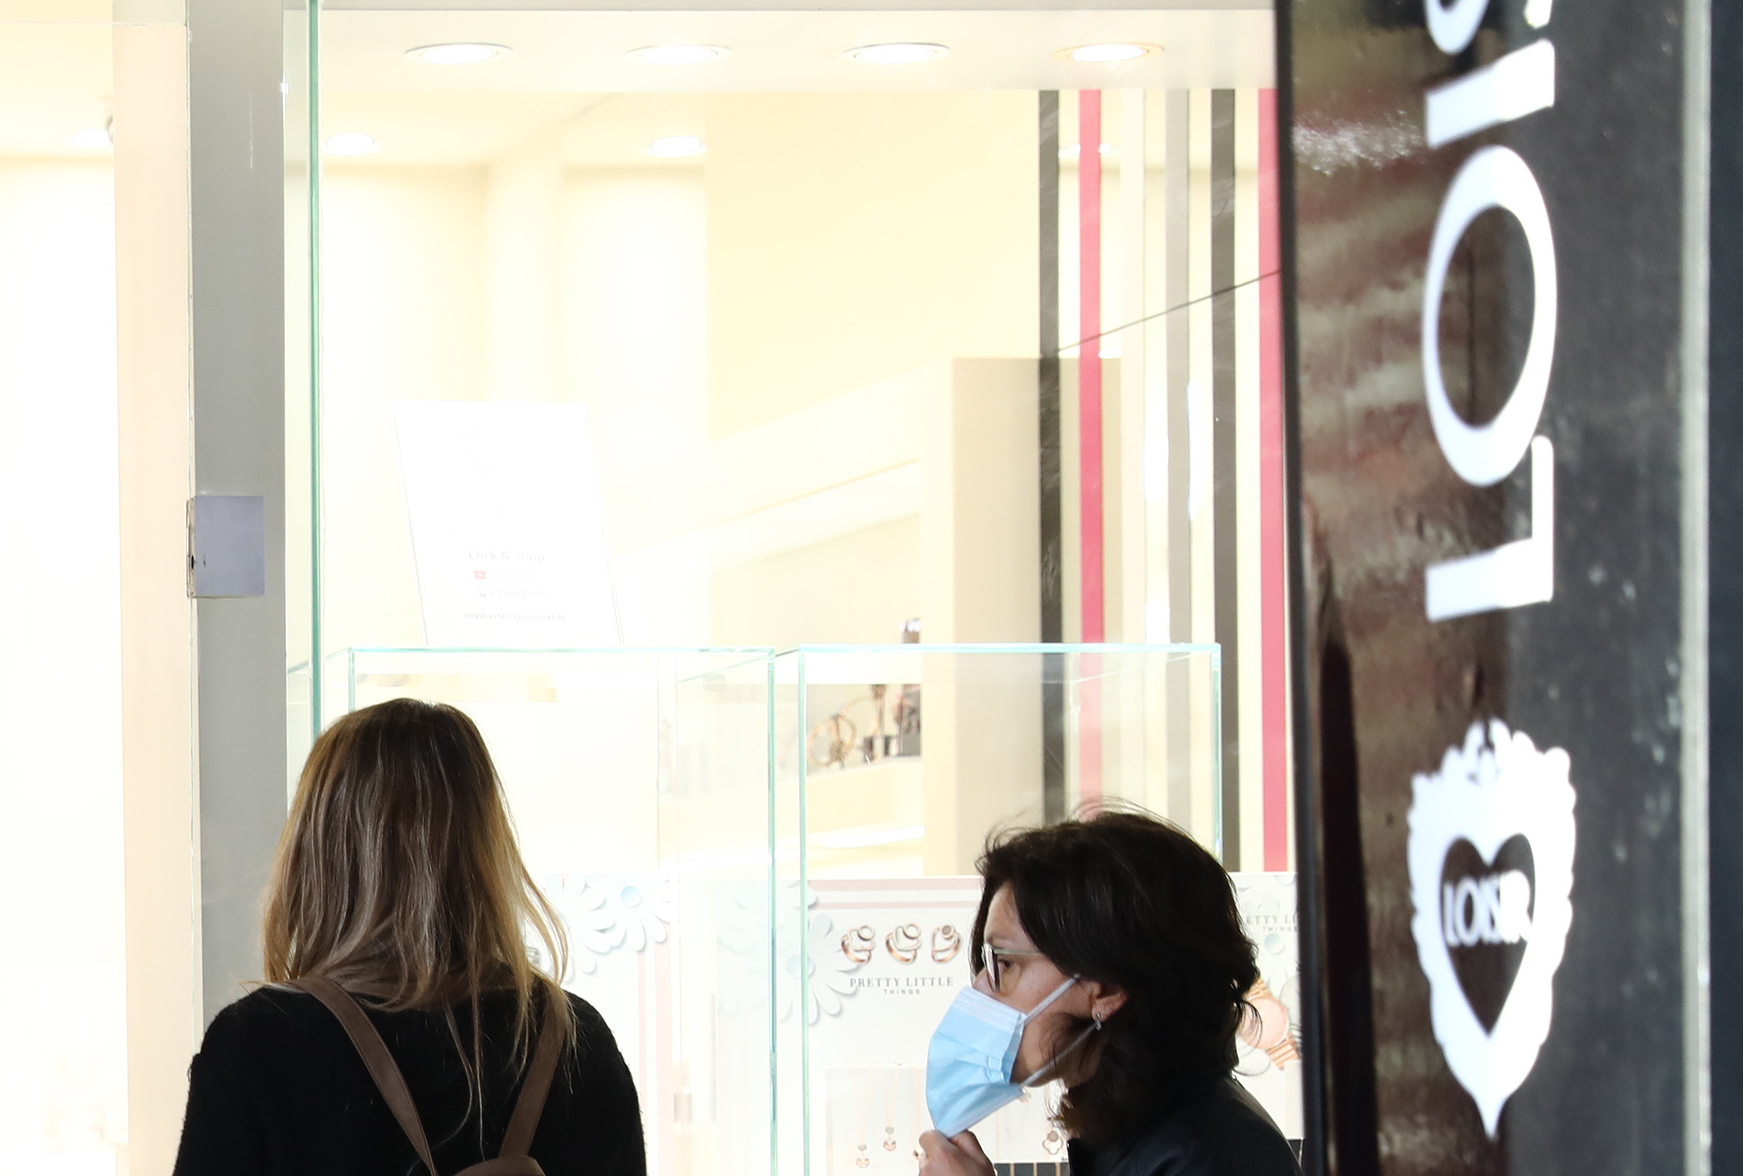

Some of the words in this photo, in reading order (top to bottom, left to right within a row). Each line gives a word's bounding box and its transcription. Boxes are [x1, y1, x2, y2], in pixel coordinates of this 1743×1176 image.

[468, 550, 496, 561] Click
[501, 551, 510, 560] &
[850, 977, 900, 988] PRETTY
[906, 976, 954, 987] LITTLE
